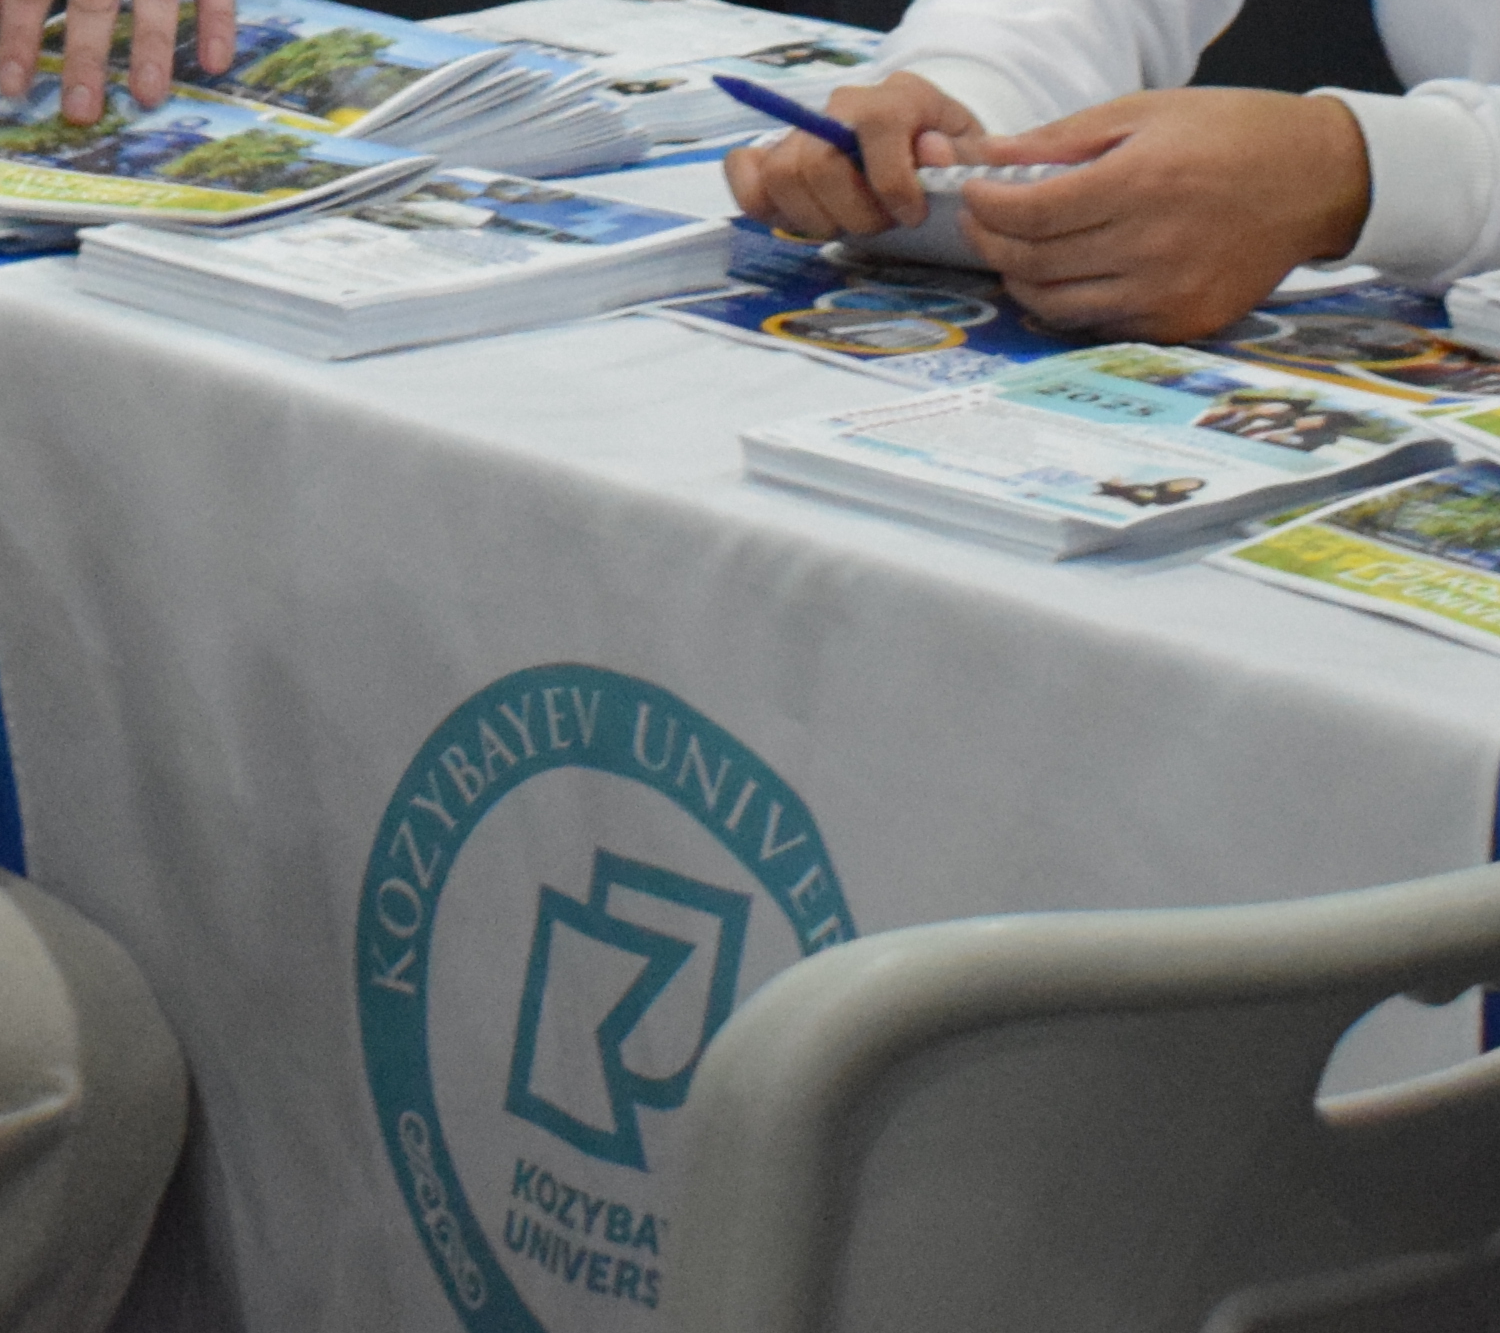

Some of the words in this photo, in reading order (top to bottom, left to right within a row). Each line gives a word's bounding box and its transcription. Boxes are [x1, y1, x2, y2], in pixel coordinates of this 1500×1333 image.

[371, 686, 602, 996] KOZYBAYEV
[632, 701, 850, 950] UNIVER
[511, 1156, 668, 1258] KOZYBA
[502, 1208, 662, 1311] UNIVERS
